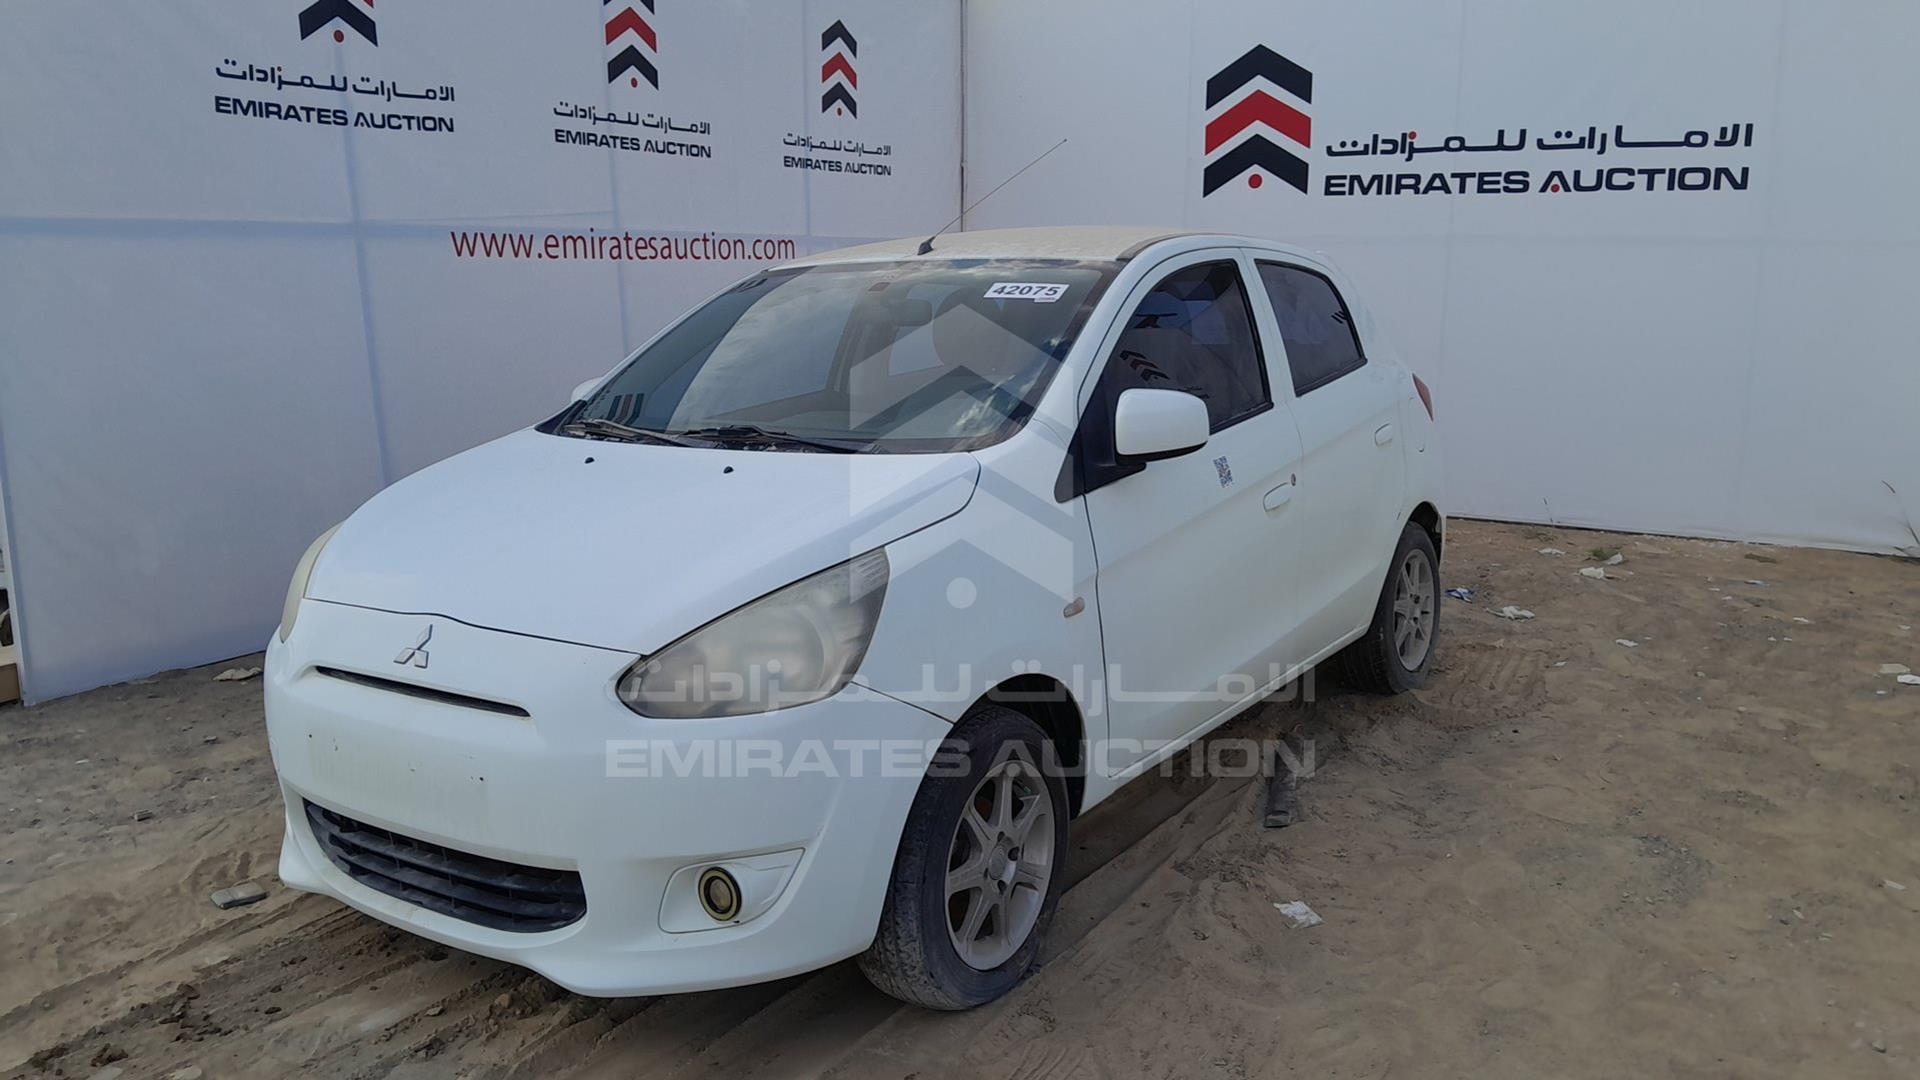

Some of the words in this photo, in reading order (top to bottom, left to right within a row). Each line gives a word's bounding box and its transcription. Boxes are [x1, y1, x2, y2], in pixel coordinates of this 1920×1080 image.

[215, 58, 348, 91] للمزادات
[214, 95, 349, 126] EMIRATES
[353, 111, 455, 133] AUCTION
[553, 101, 639, 125] للمزادات
[554, 128, 641, 152] EMIRATES
[643, 139, 712, 158] AUCTION
[1325, 128, 1527, 162] للمزادات
[783, 155, 843, 173] EMIRATES
[844, 162, 892, 176] AUCTION
[1323, 171, 1531, 197] EMIRATES
[1538, 166, 1750, 194] AUCTION
[450, 227, 796, 261] www.emiratesauction.com
[992, 285, 1061, 296] 42075
